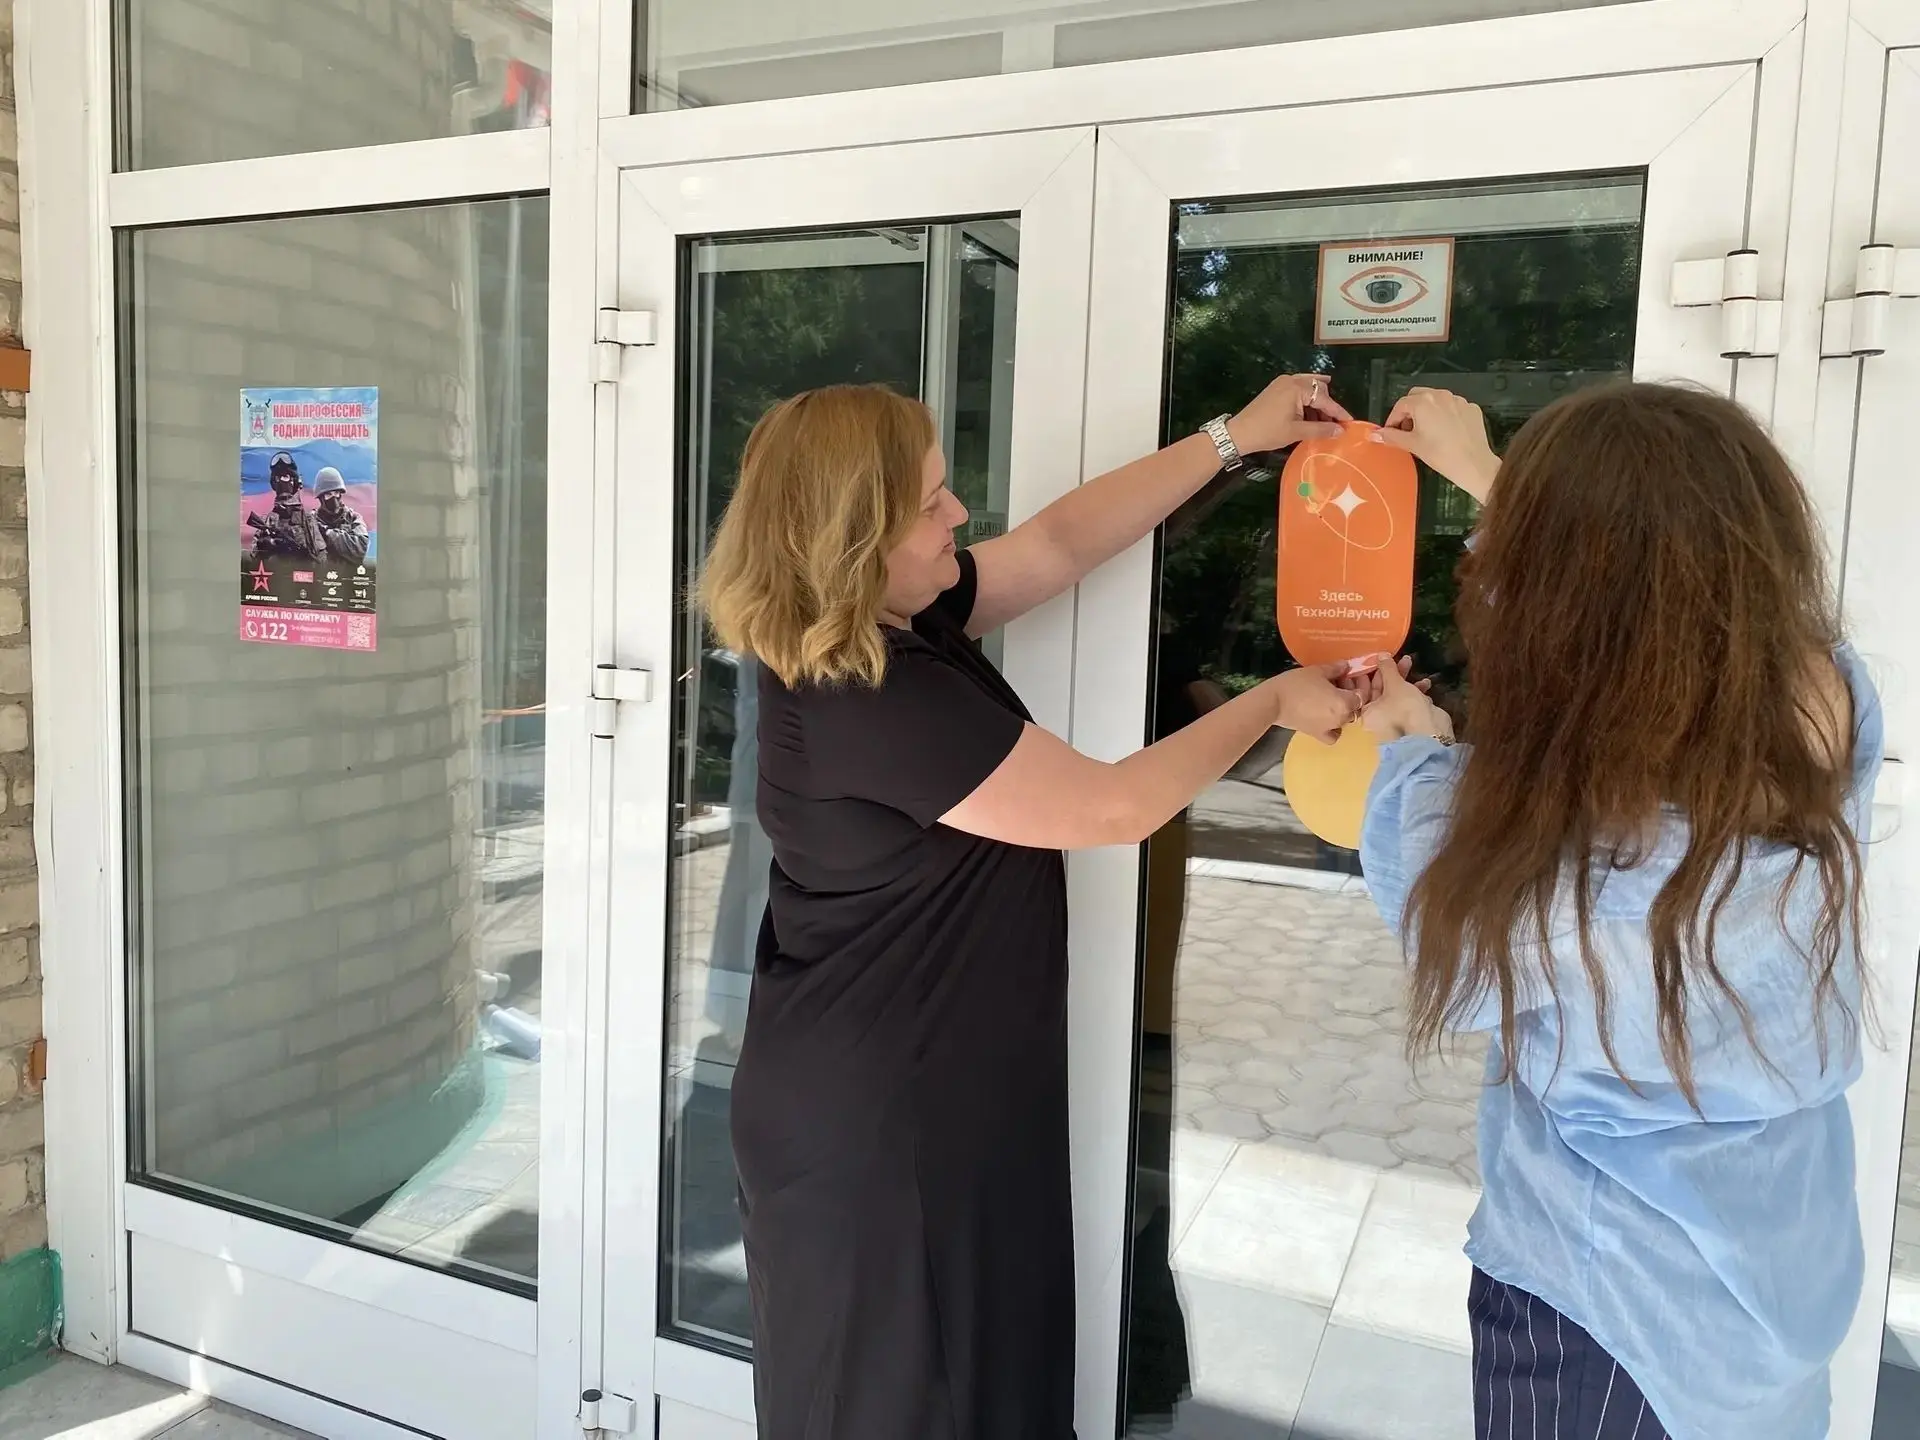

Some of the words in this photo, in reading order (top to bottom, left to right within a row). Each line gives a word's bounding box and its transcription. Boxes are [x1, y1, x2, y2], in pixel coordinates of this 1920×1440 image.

[1348, 250, 1424, 264] ВНИМАНИЕ!
[1327, 319, 1359, 327] ВЕДЕТСЯ
[1360, 316, 1437, 326] ВИДЕОНАБЛЮДЕНИЕ
[273, 404, 300, 418] НАША
[273, 423, 310, 439] РОДИНУ
[312, 423, 369, 440] ЗАЩИЩАТЬ
[1319, 589, 1364, 602] Здесь
[245, 609, 279, 620] СЛУЖБА
[280, 611, 292, 621] ПО
[293, 612, 341, 623] КОНТРАКТУ
[1293, 605, 1390, 621] ТехноНаучно
[260, 622, 288, 640] 122
